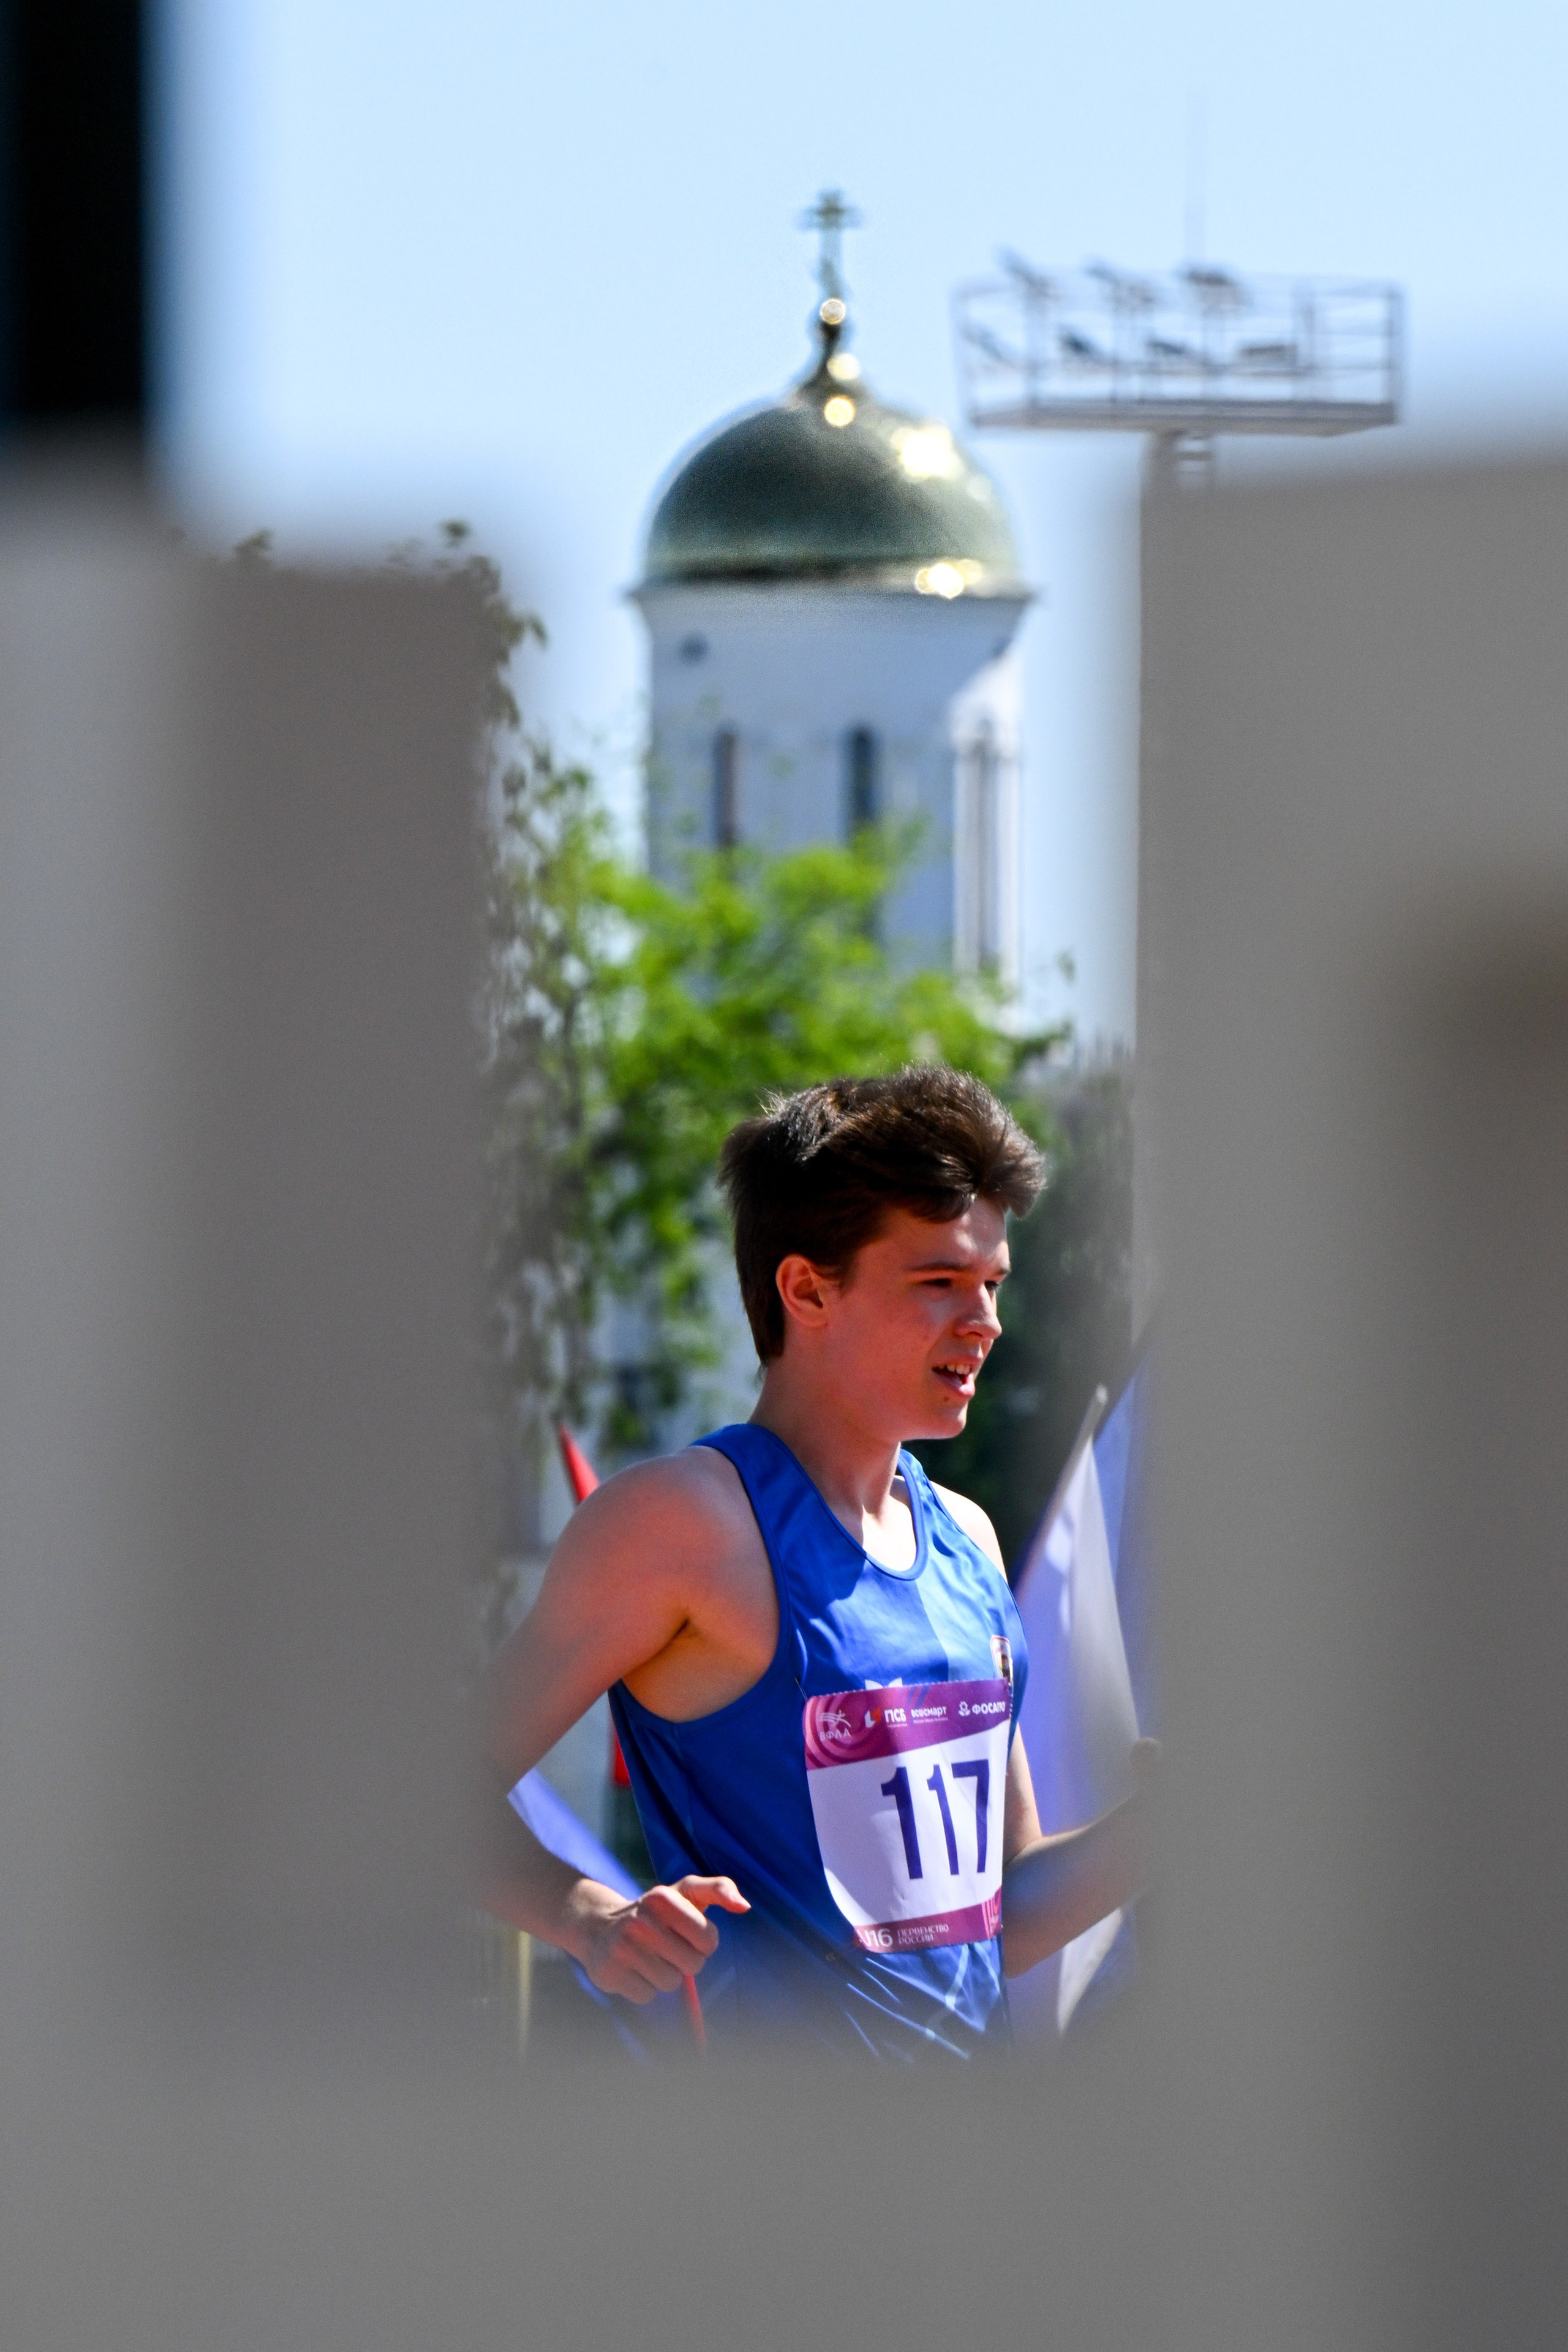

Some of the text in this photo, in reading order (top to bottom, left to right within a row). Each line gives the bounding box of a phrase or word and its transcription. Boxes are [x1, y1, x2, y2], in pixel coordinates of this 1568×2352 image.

[884, 1708, 907, 1723] ПСБ
[820, 1728, 851, 1741] ВФЛА
[881, 1759, 989, 1880] 117
[898, 1934, 934, 1945] РОССИИ
